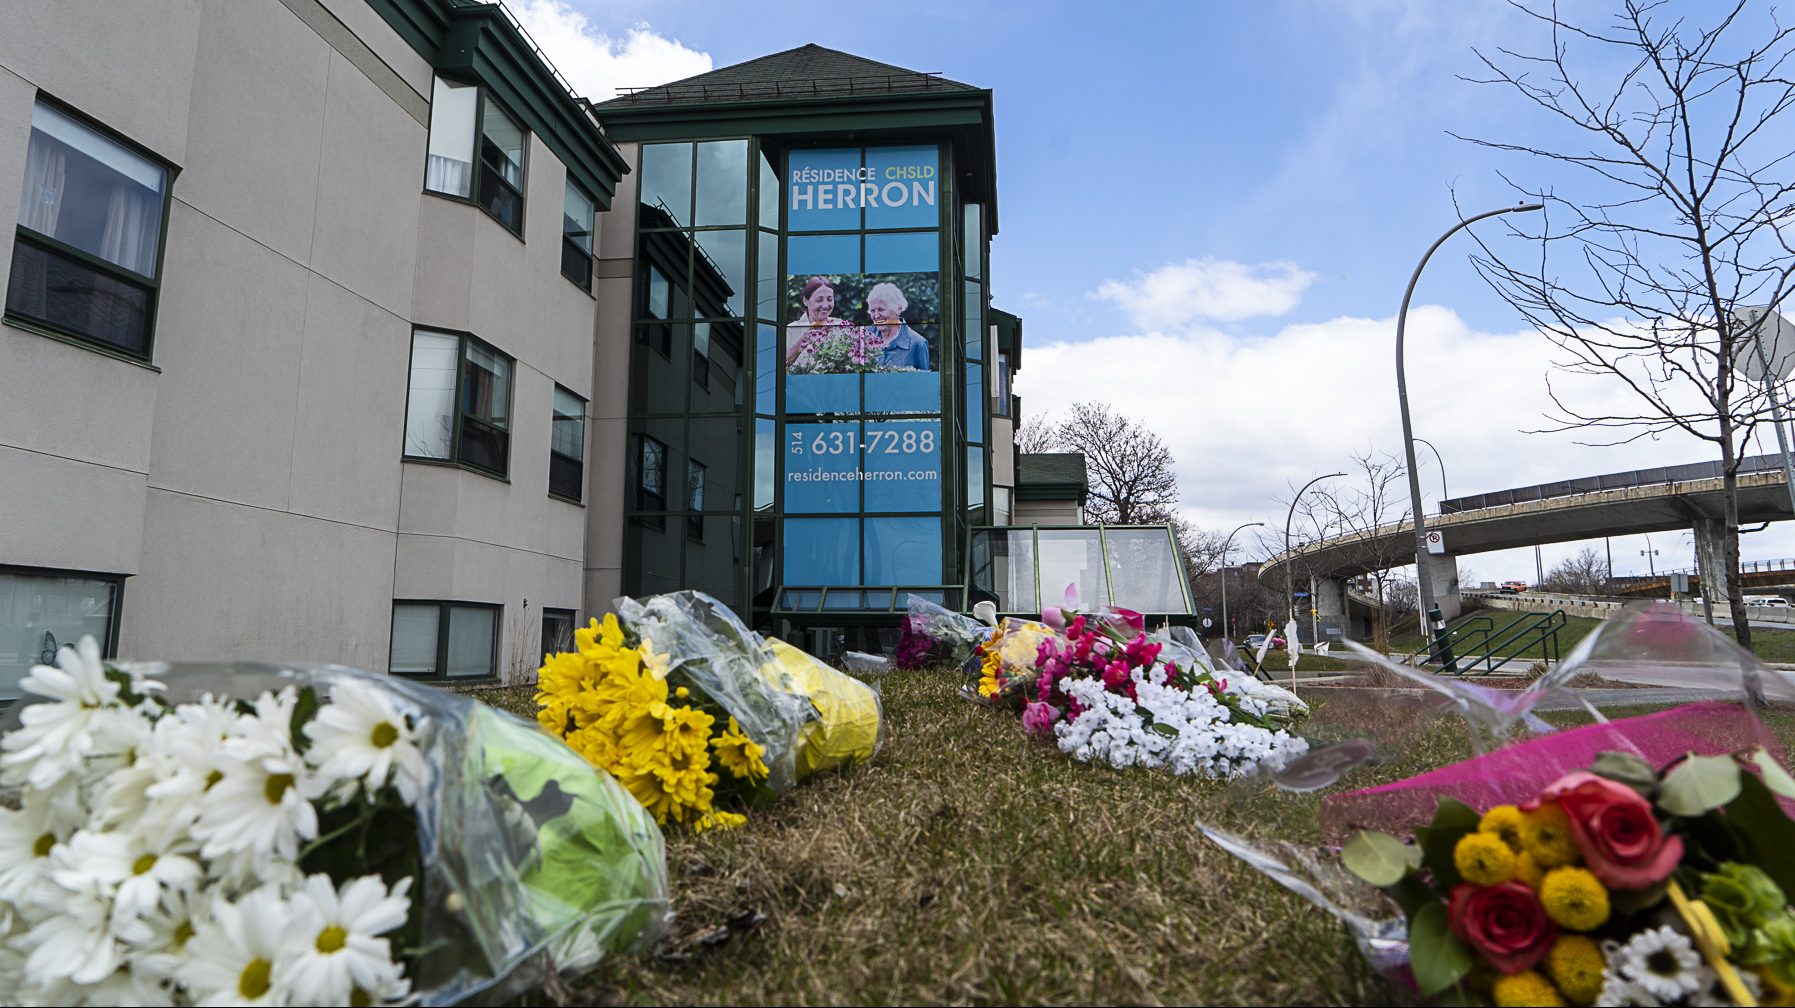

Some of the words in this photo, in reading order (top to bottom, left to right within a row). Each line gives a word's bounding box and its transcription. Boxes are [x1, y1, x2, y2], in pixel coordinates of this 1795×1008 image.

[793, 166, 876, 183] RÉSIDENCE
[885, 165, 935, 180] CHSLD
[792, 180, 935, 210] HERRON
[791, 431, 803, 455] 514
[812, 430, 935, 455] 631-7288
[788, 466, 937, 482] residenceherron.com
